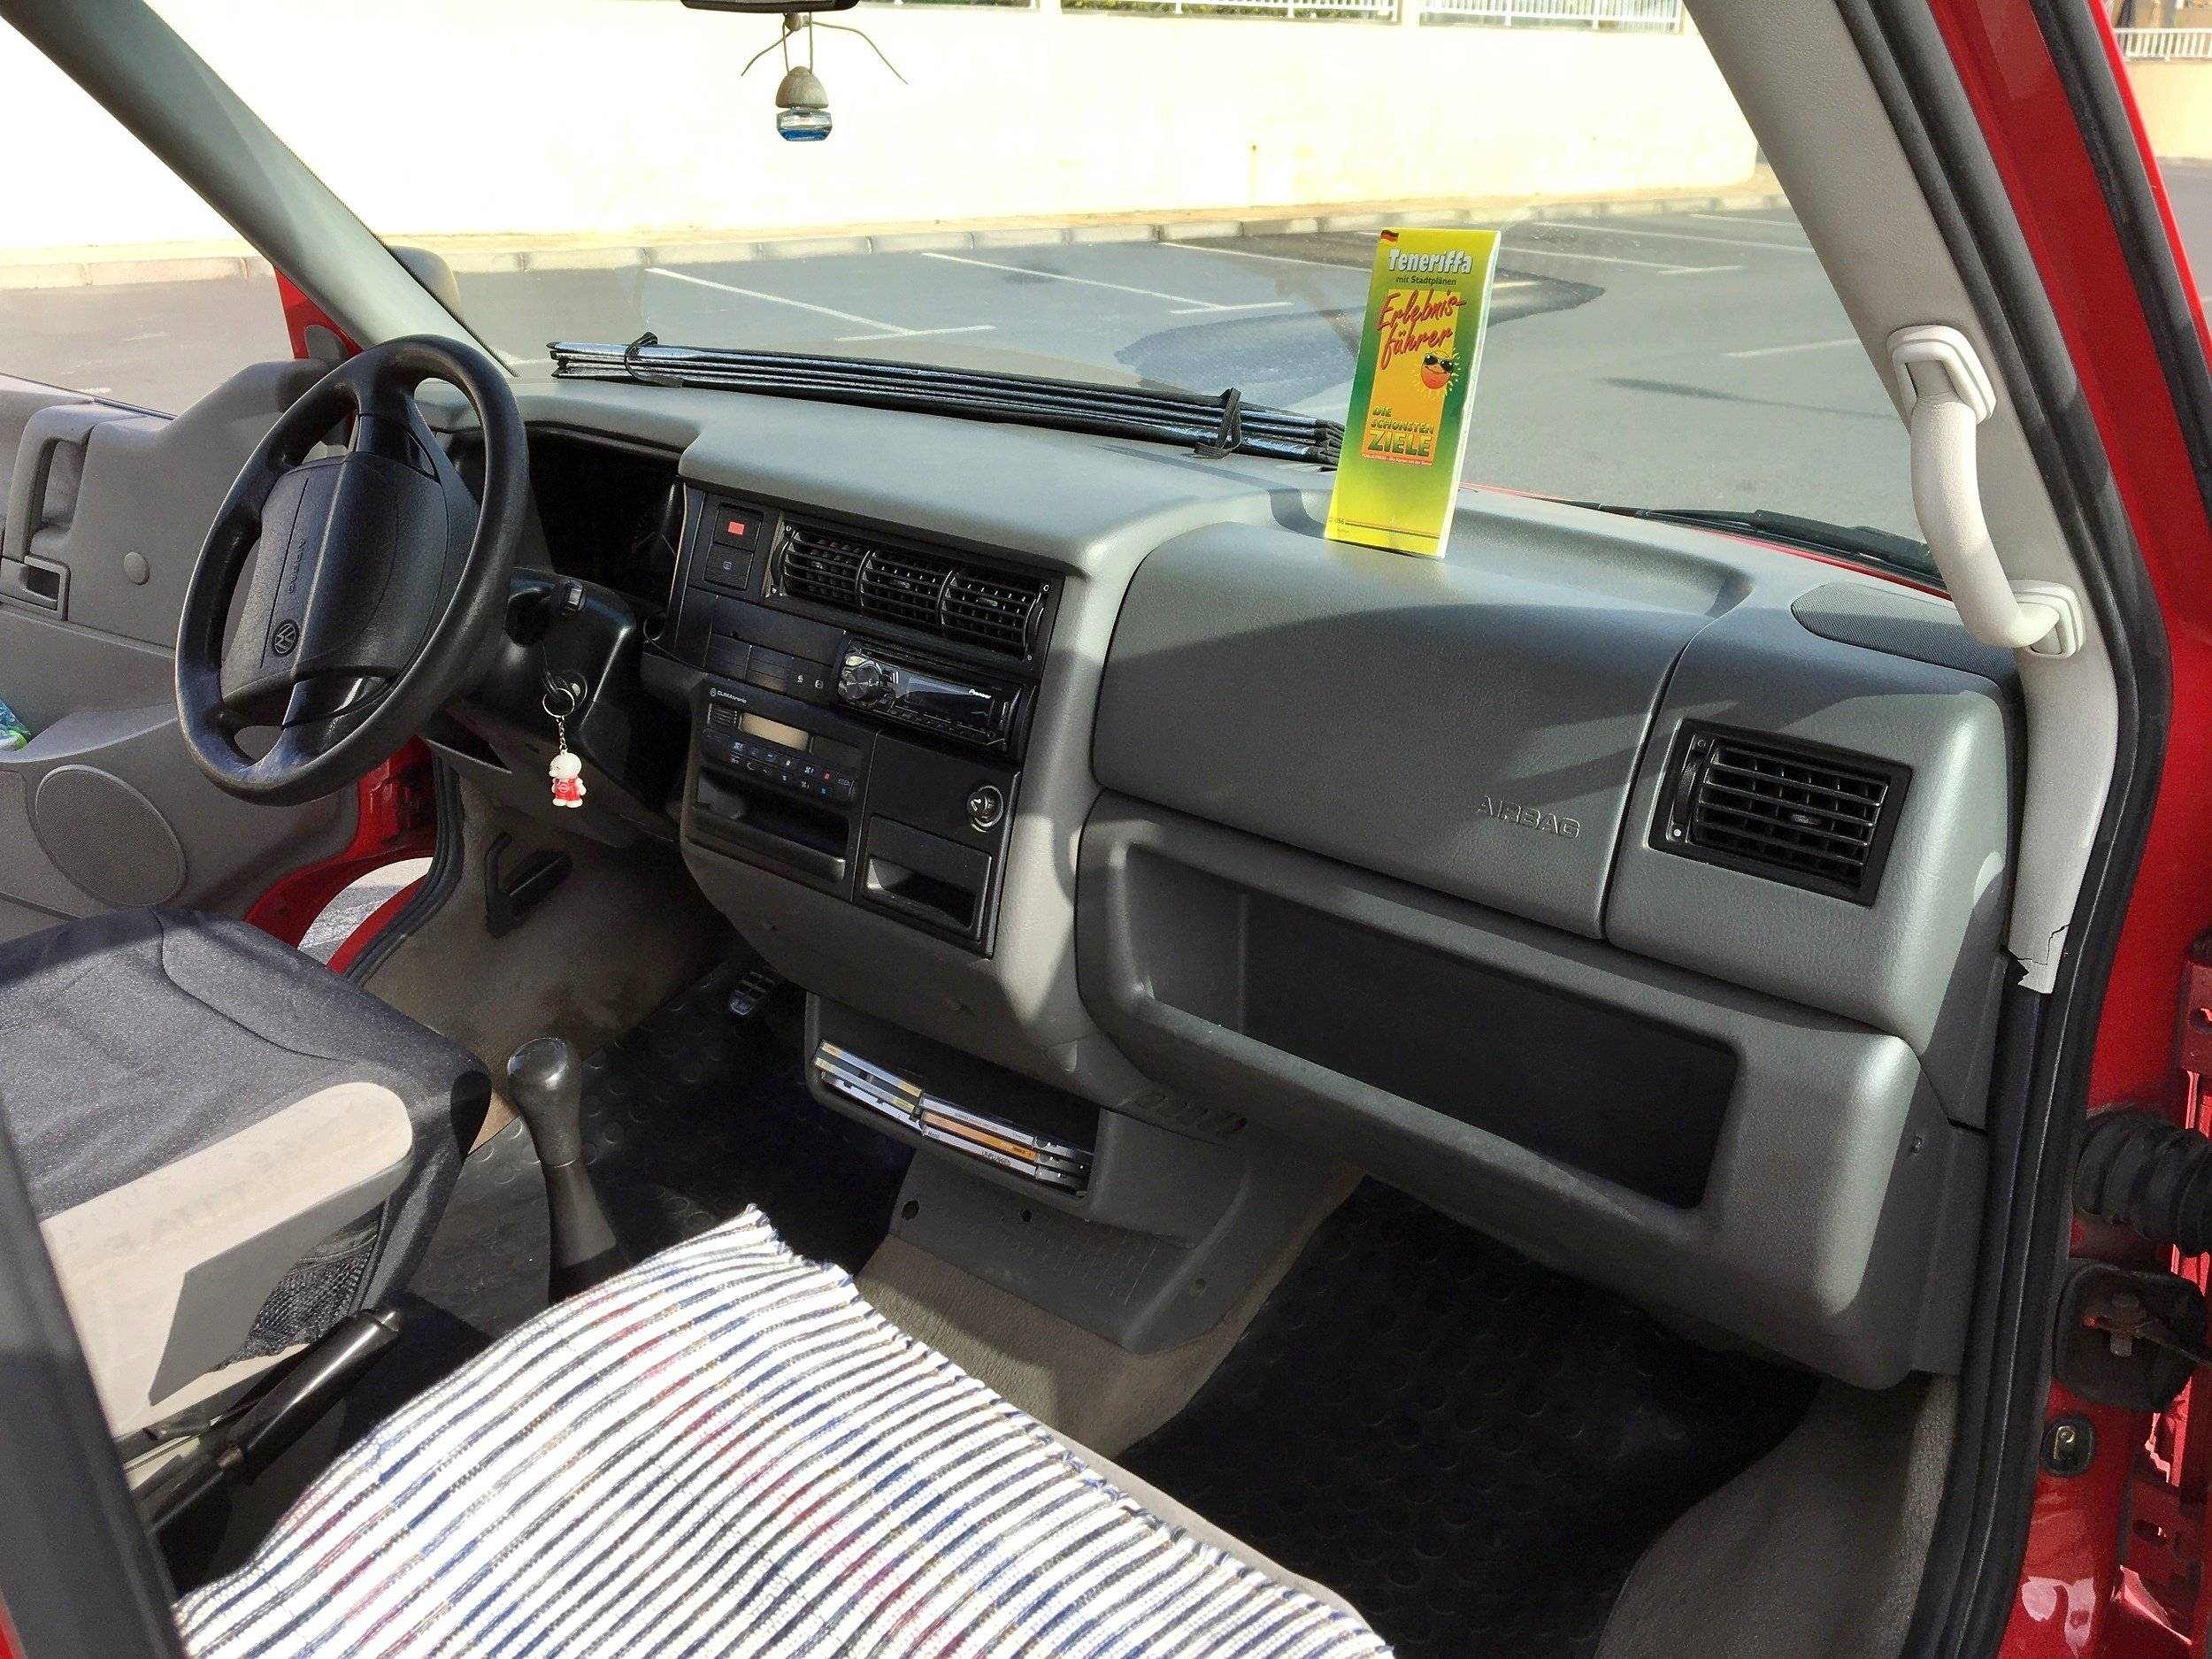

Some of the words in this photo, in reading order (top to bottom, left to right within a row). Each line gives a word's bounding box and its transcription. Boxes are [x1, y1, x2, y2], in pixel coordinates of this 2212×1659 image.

[1388, 249, 1472, 274] Teneriffa
[1395, 275, 1409, 284] mit
[1410, 275, 1457, 287] Stadtplänen
[1372, 406, 1392, 418] DIE
[1368, 429, 1432, 457] ZIELE
[1473, 795, 1581, 839] AIRBAG
